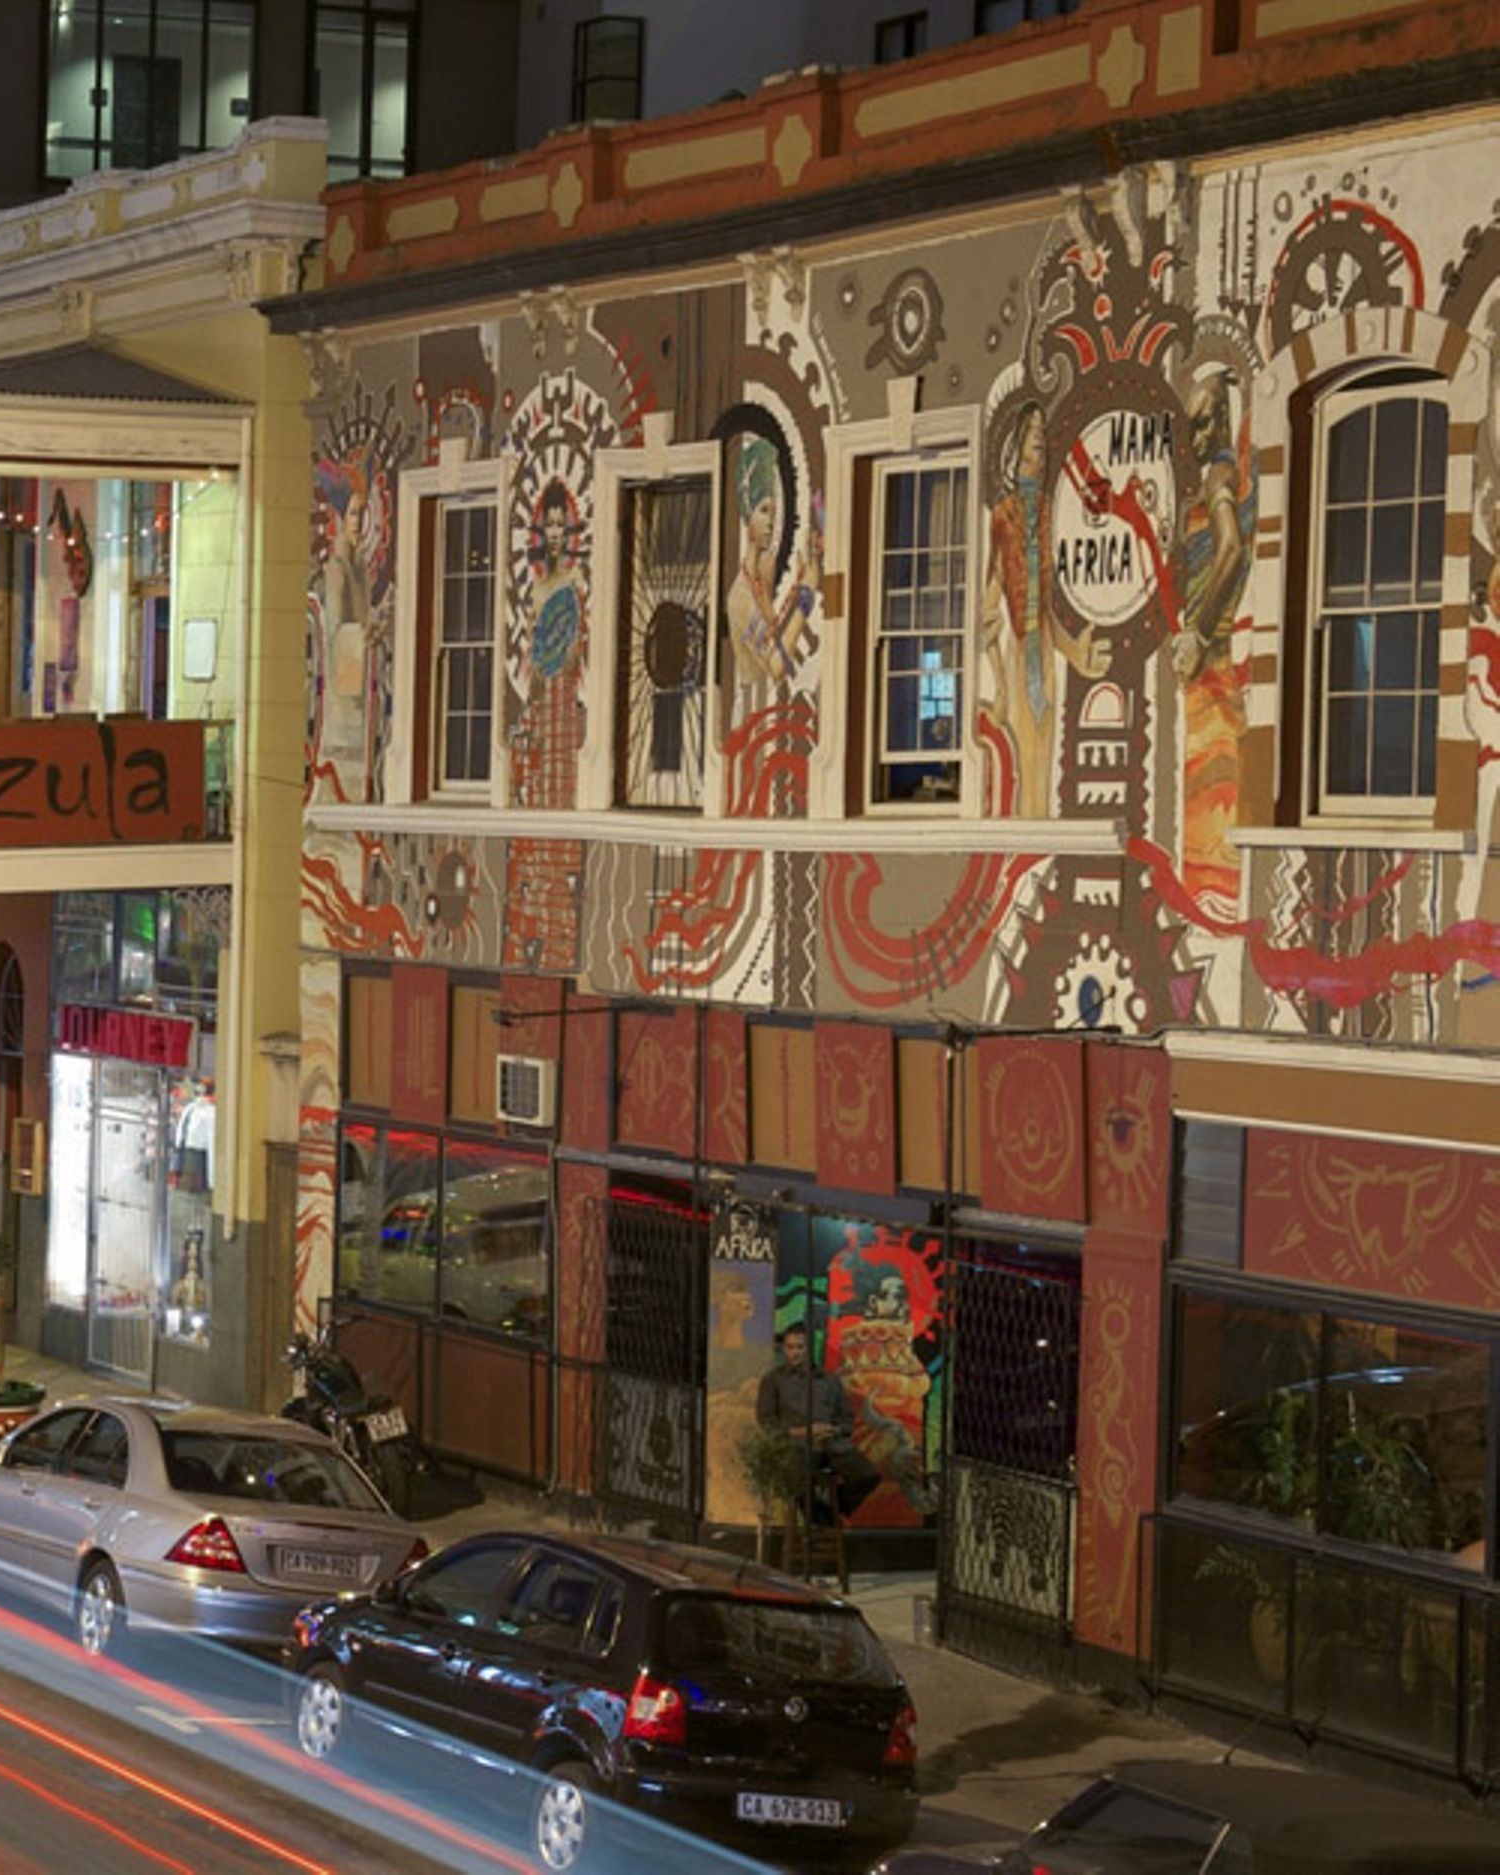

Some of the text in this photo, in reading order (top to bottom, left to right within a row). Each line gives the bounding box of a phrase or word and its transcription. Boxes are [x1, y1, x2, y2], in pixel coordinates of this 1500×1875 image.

[1109, 412, 1173, 467] MAMA
[1057, 532, 1133, 586] AFRICA
[715, 1234, 775, 1260] AFRICA
[742, 1794, 764, 1816] CA
